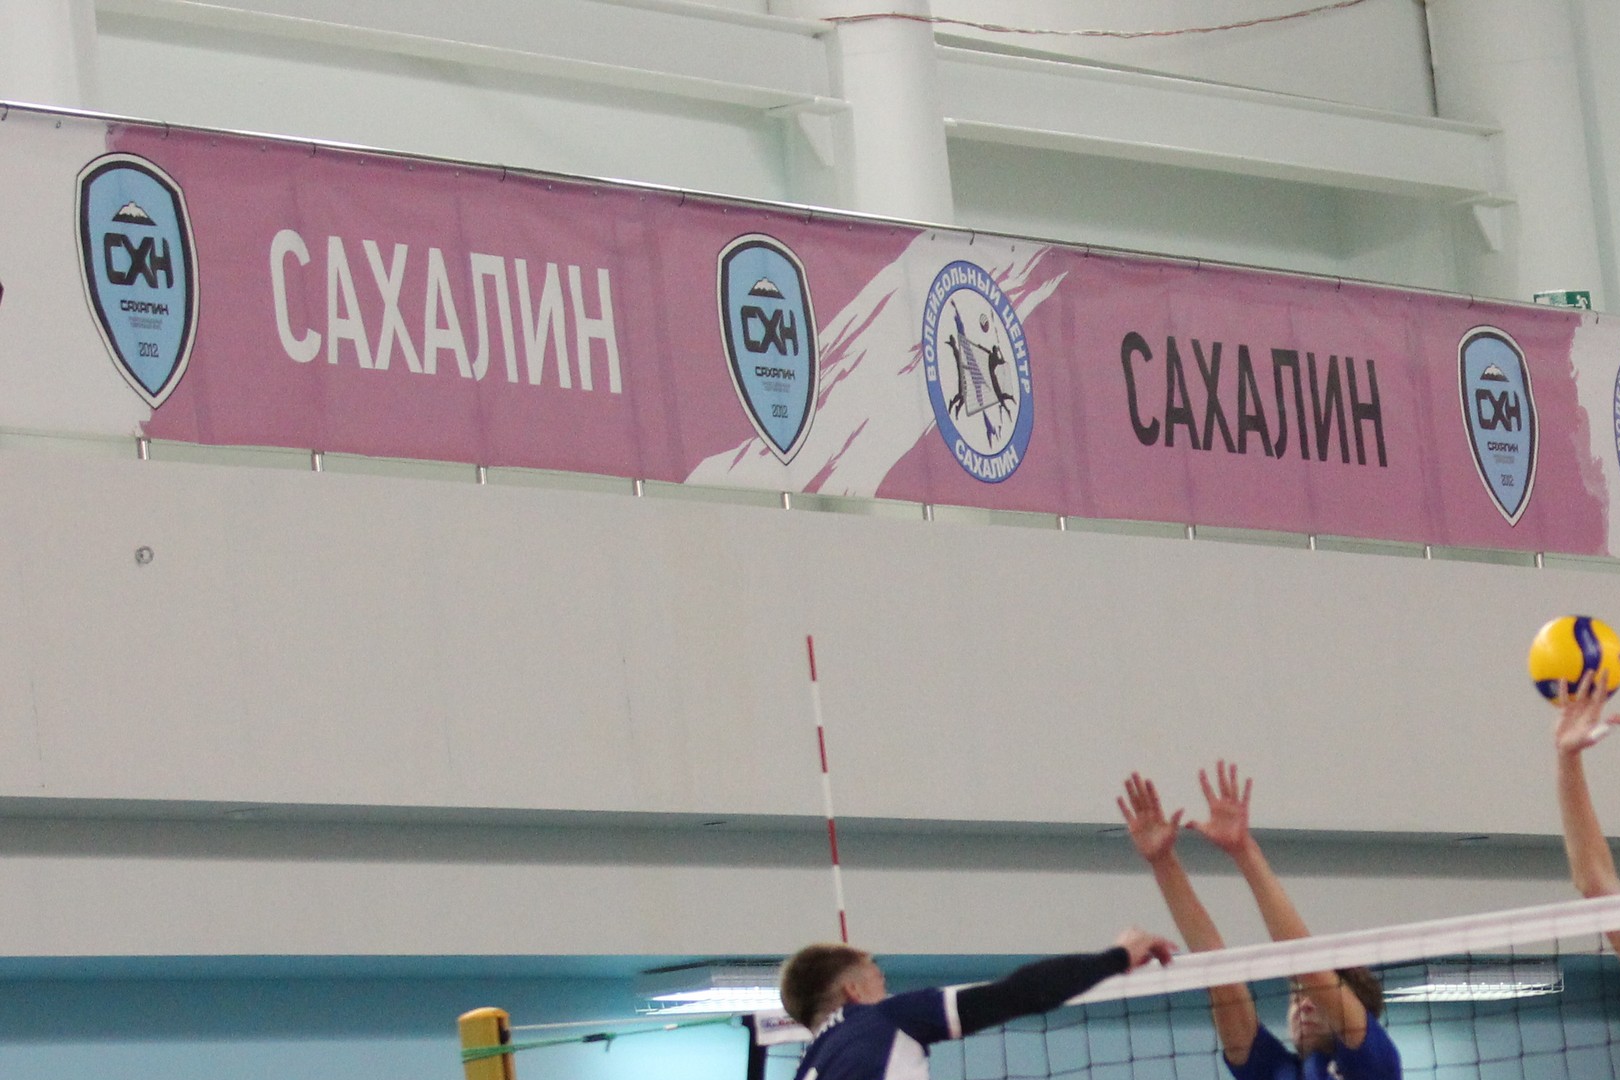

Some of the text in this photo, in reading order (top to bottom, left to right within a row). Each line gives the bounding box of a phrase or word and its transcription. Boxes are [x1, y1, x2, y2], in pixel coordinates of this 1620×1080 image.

[120, 299, 169, 315] САХАЛИН
[270, 228, 623, 394] САХАЛИН
[924, 266, 1031, 394] ВОЛЕЙБОЛЬНЫЙ ЦЕНТР
[139, 342, 159, 358] 2012
[755, 366, 796, 380] САХАЛИН
[1120, 331, 1388, 468] САХАЛИН
[955, 439, 1019, 478] САХАЛИН
